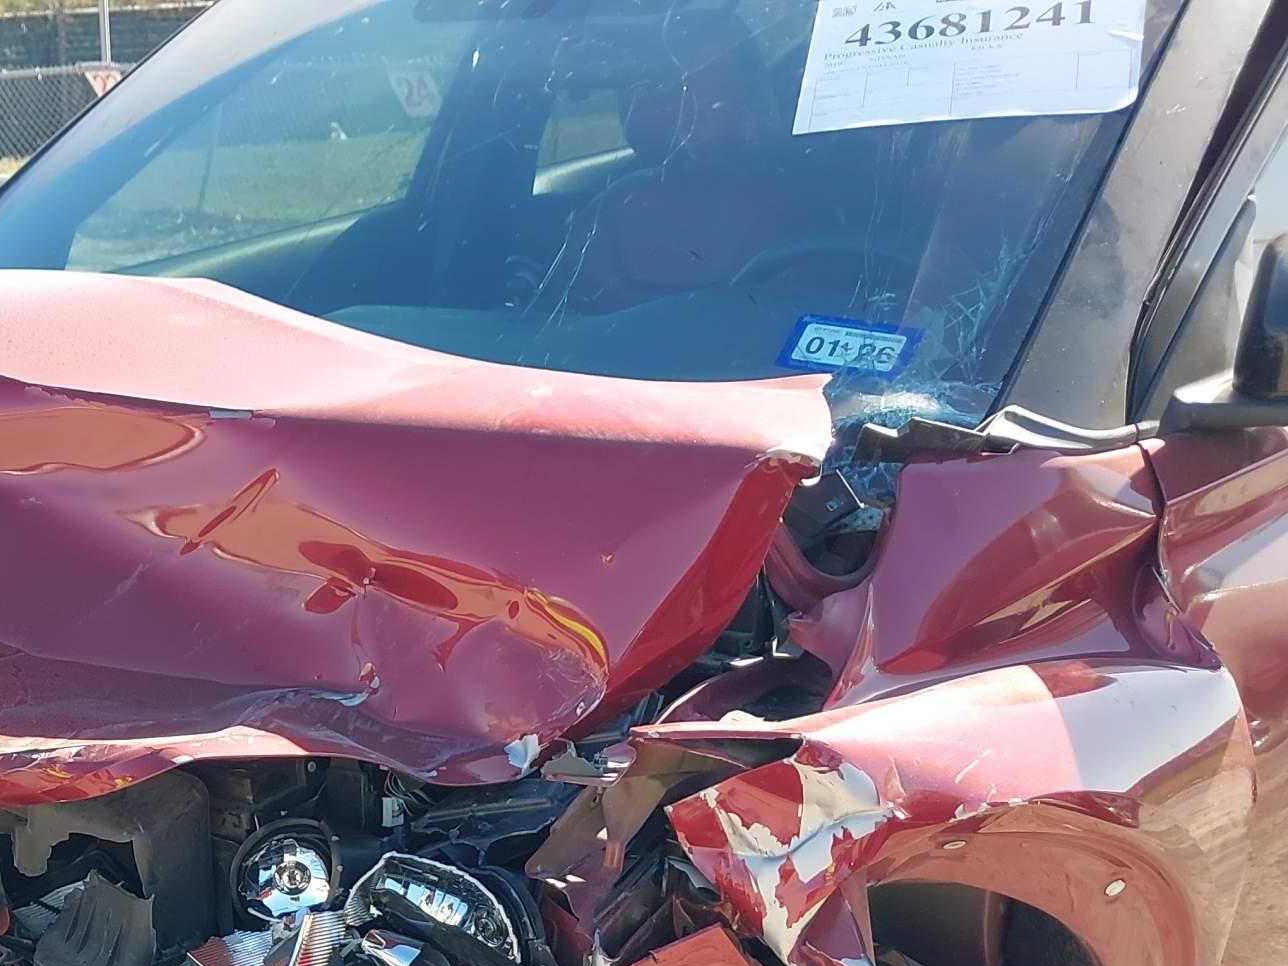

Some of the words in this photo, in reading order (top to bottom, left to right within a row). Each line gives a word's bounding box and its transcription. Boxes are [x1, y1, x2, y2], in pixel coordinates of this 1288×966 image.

[844, 0, 1096, 47] 43681241
[960, 32, 1023, 45] Insurance
[805, 336, 841, 358] 01
